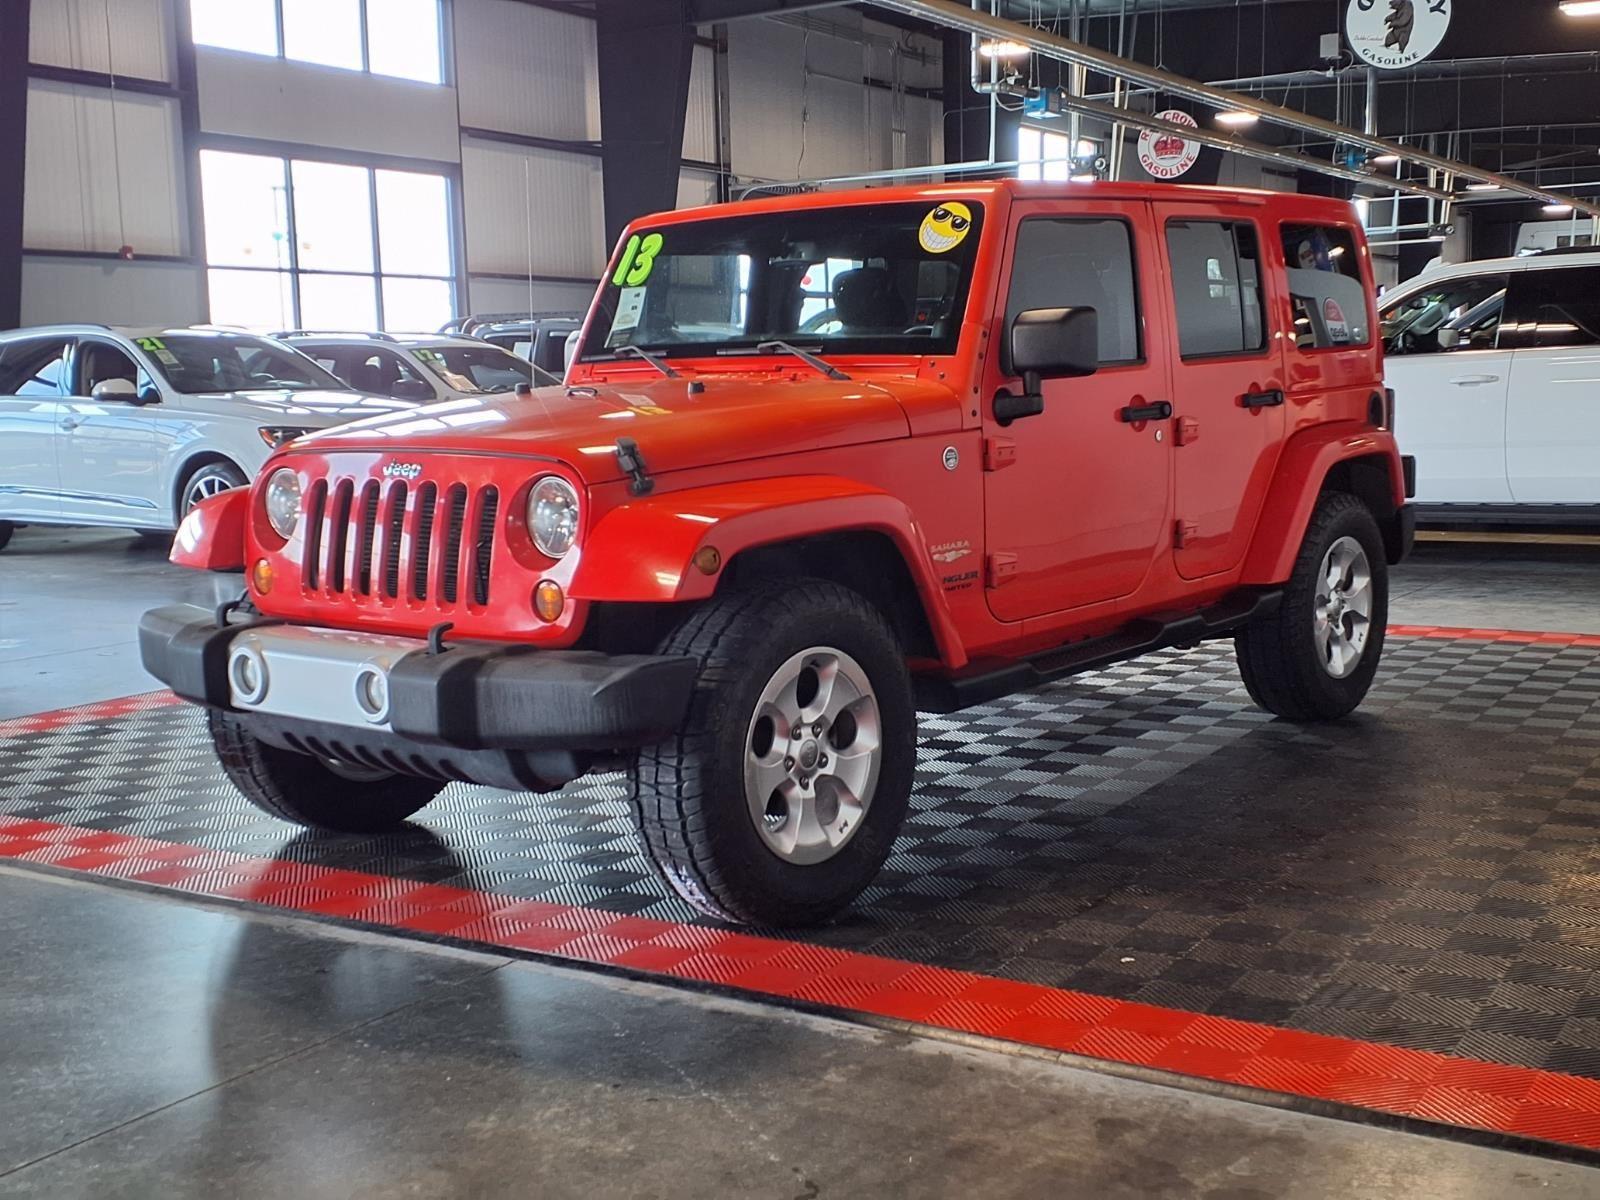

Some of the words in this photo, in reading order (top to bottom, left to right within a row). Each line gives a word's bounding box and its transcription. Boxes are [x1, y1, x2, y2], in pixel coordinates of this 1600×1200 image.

[1362, 48, 1419, 65] GASOLINE
[1163, 112, 1197, 129] CROW
[1141, 152, 1196, 177] GASOLINE
[612, 233, 664, 287] 13
[135, 337, 166, 351] 21
[382, 461, 422, 480] Jeep
[930, 540, 970, 553] SAHARA
[943, 571, 978, 584] NGLER
